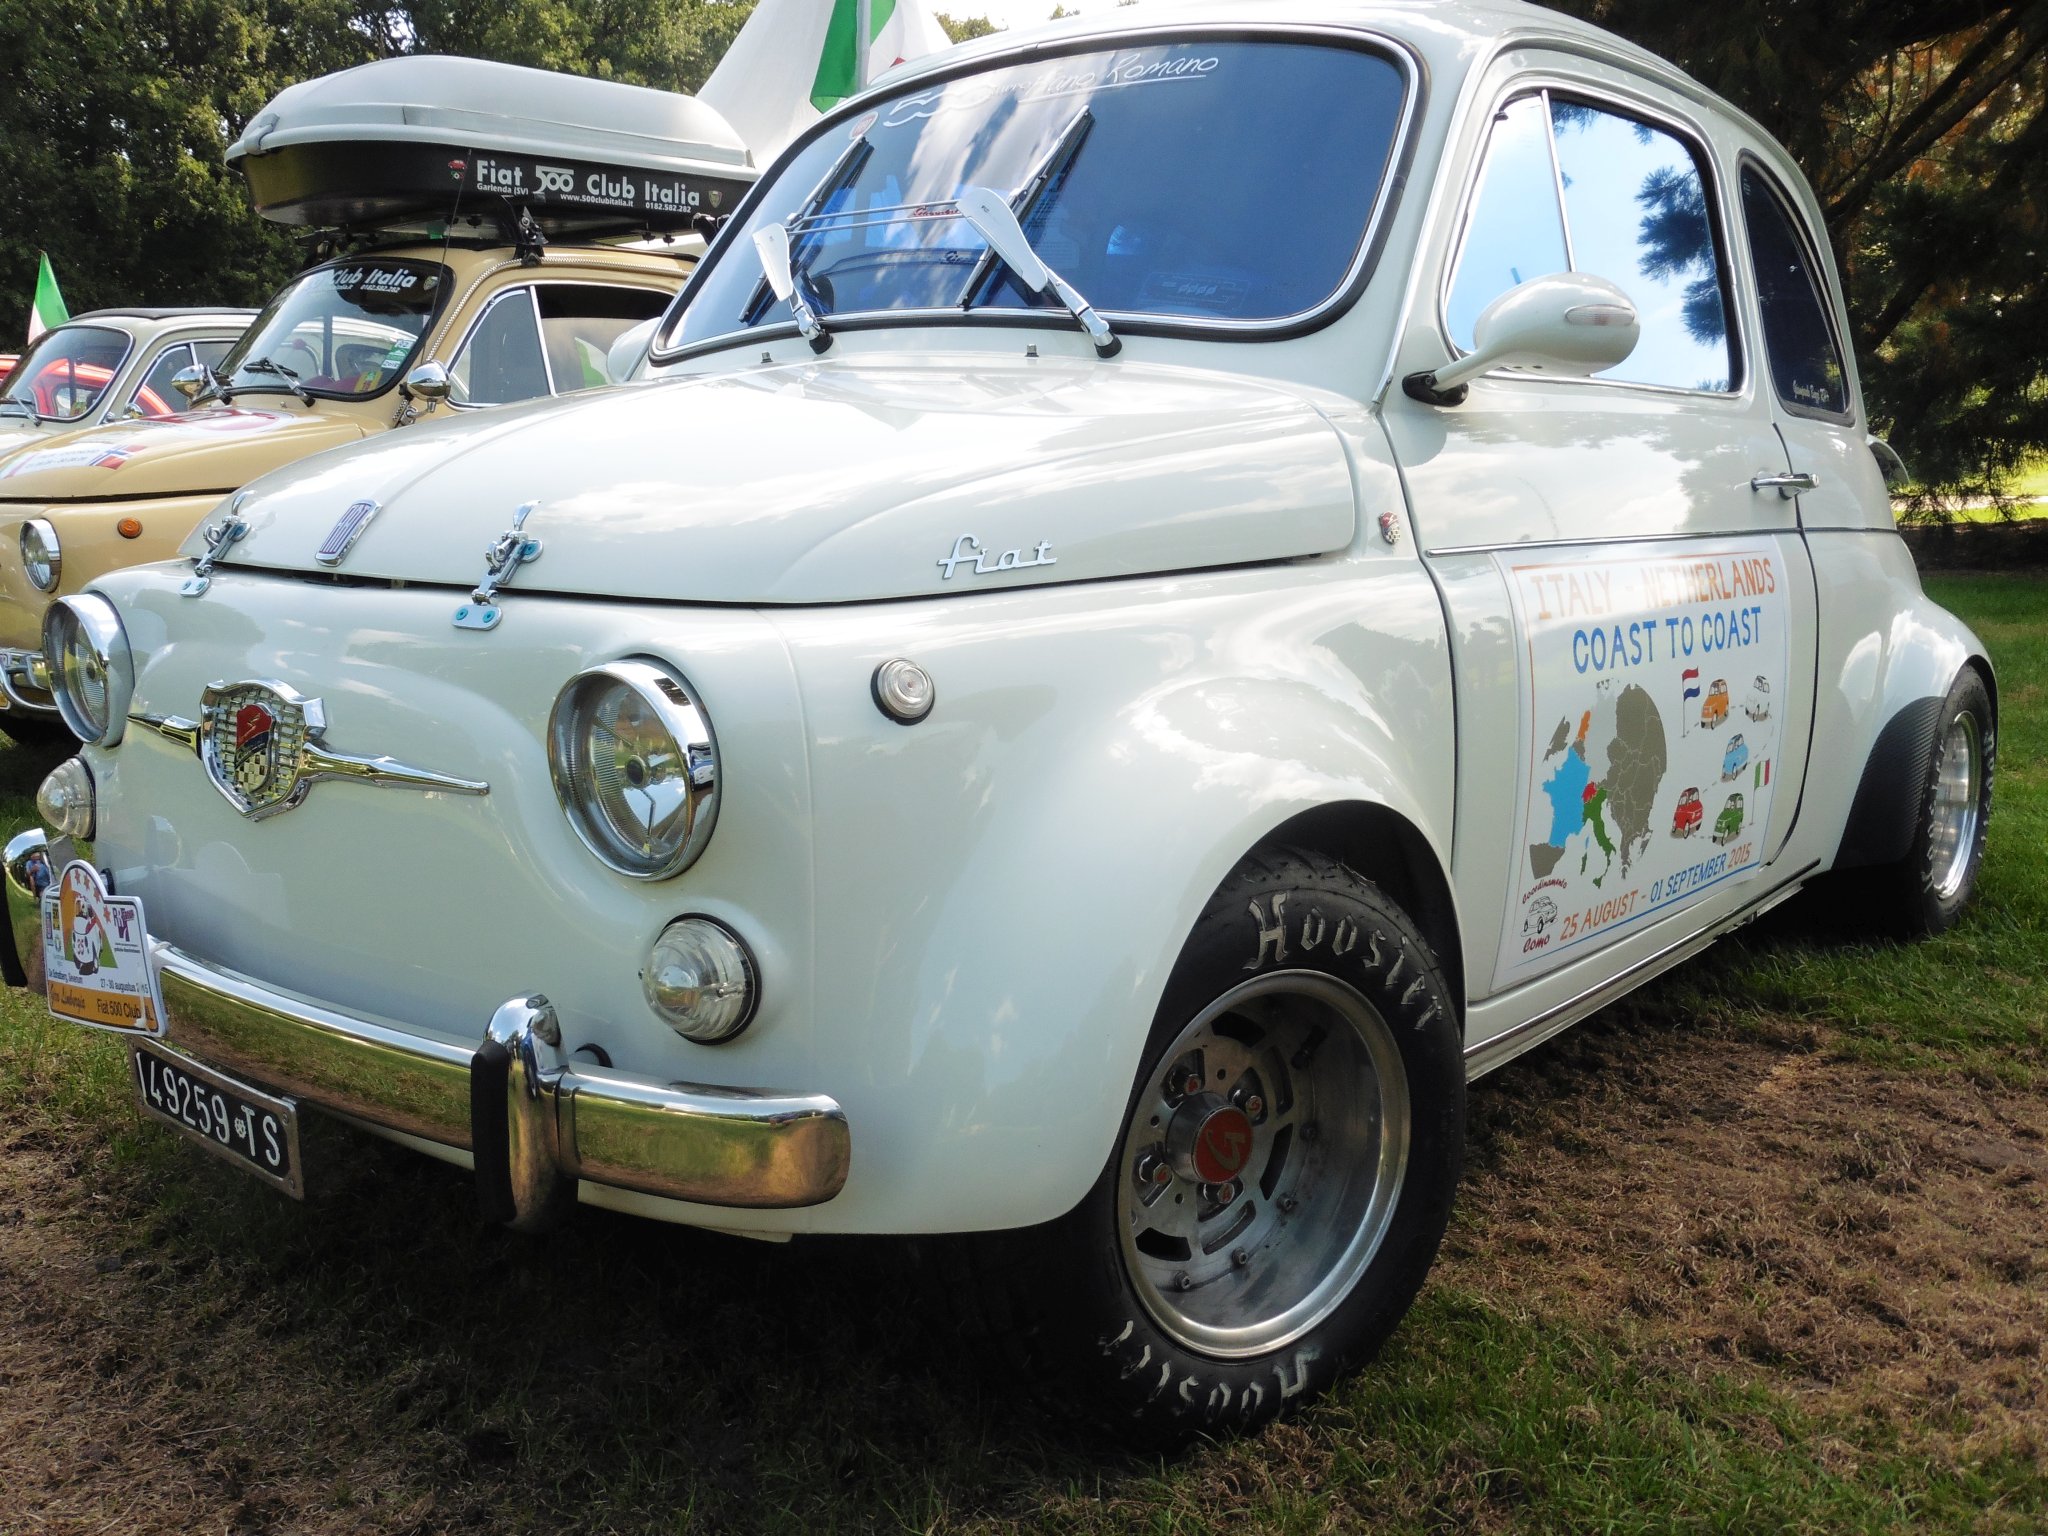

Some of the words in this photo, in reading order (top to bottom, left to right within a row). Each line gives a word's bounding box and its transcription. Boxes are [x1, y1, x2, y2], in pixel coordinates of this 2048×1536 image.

[1106, 53, 1219, 83] Romano
[476, 160, 523, 187] Fiat
[533, 165, 574, 193] 500
[587, 174, 635, 200] Club
[645, 181, 700, 206] Italia
[477, 183, 512, 195] Garlenda
[514, 186, 529, 196] (SV)
[560, 193, 634, 208] www.500clubitalia.it
[645, 202, 692, 213] 0182.582.282
[363, 268, 418, 288] Italia
[1530, 570, 1612, 620] ITALY
[1640, 558, 1775, 608] NETHERLANDS
[1573, 620, 1656, 674] COAST
[1665, 616, 1694, 658] TO
[1701, 606, 1761, 653] COAST
[1560, 914, 1578, 941] 25
[1580, 889, 1640, 932] AUGUST
[1666, 853, 1728, 896] SEPTEMBER
[1727, 842, 1753, 869] 2015
[114, 981, 136, 993] augustus
[97, 998, 109, 1015] Fiat
[109, 1001, 122, 1017] 500
[123, 1003, 142, 1019] Club
